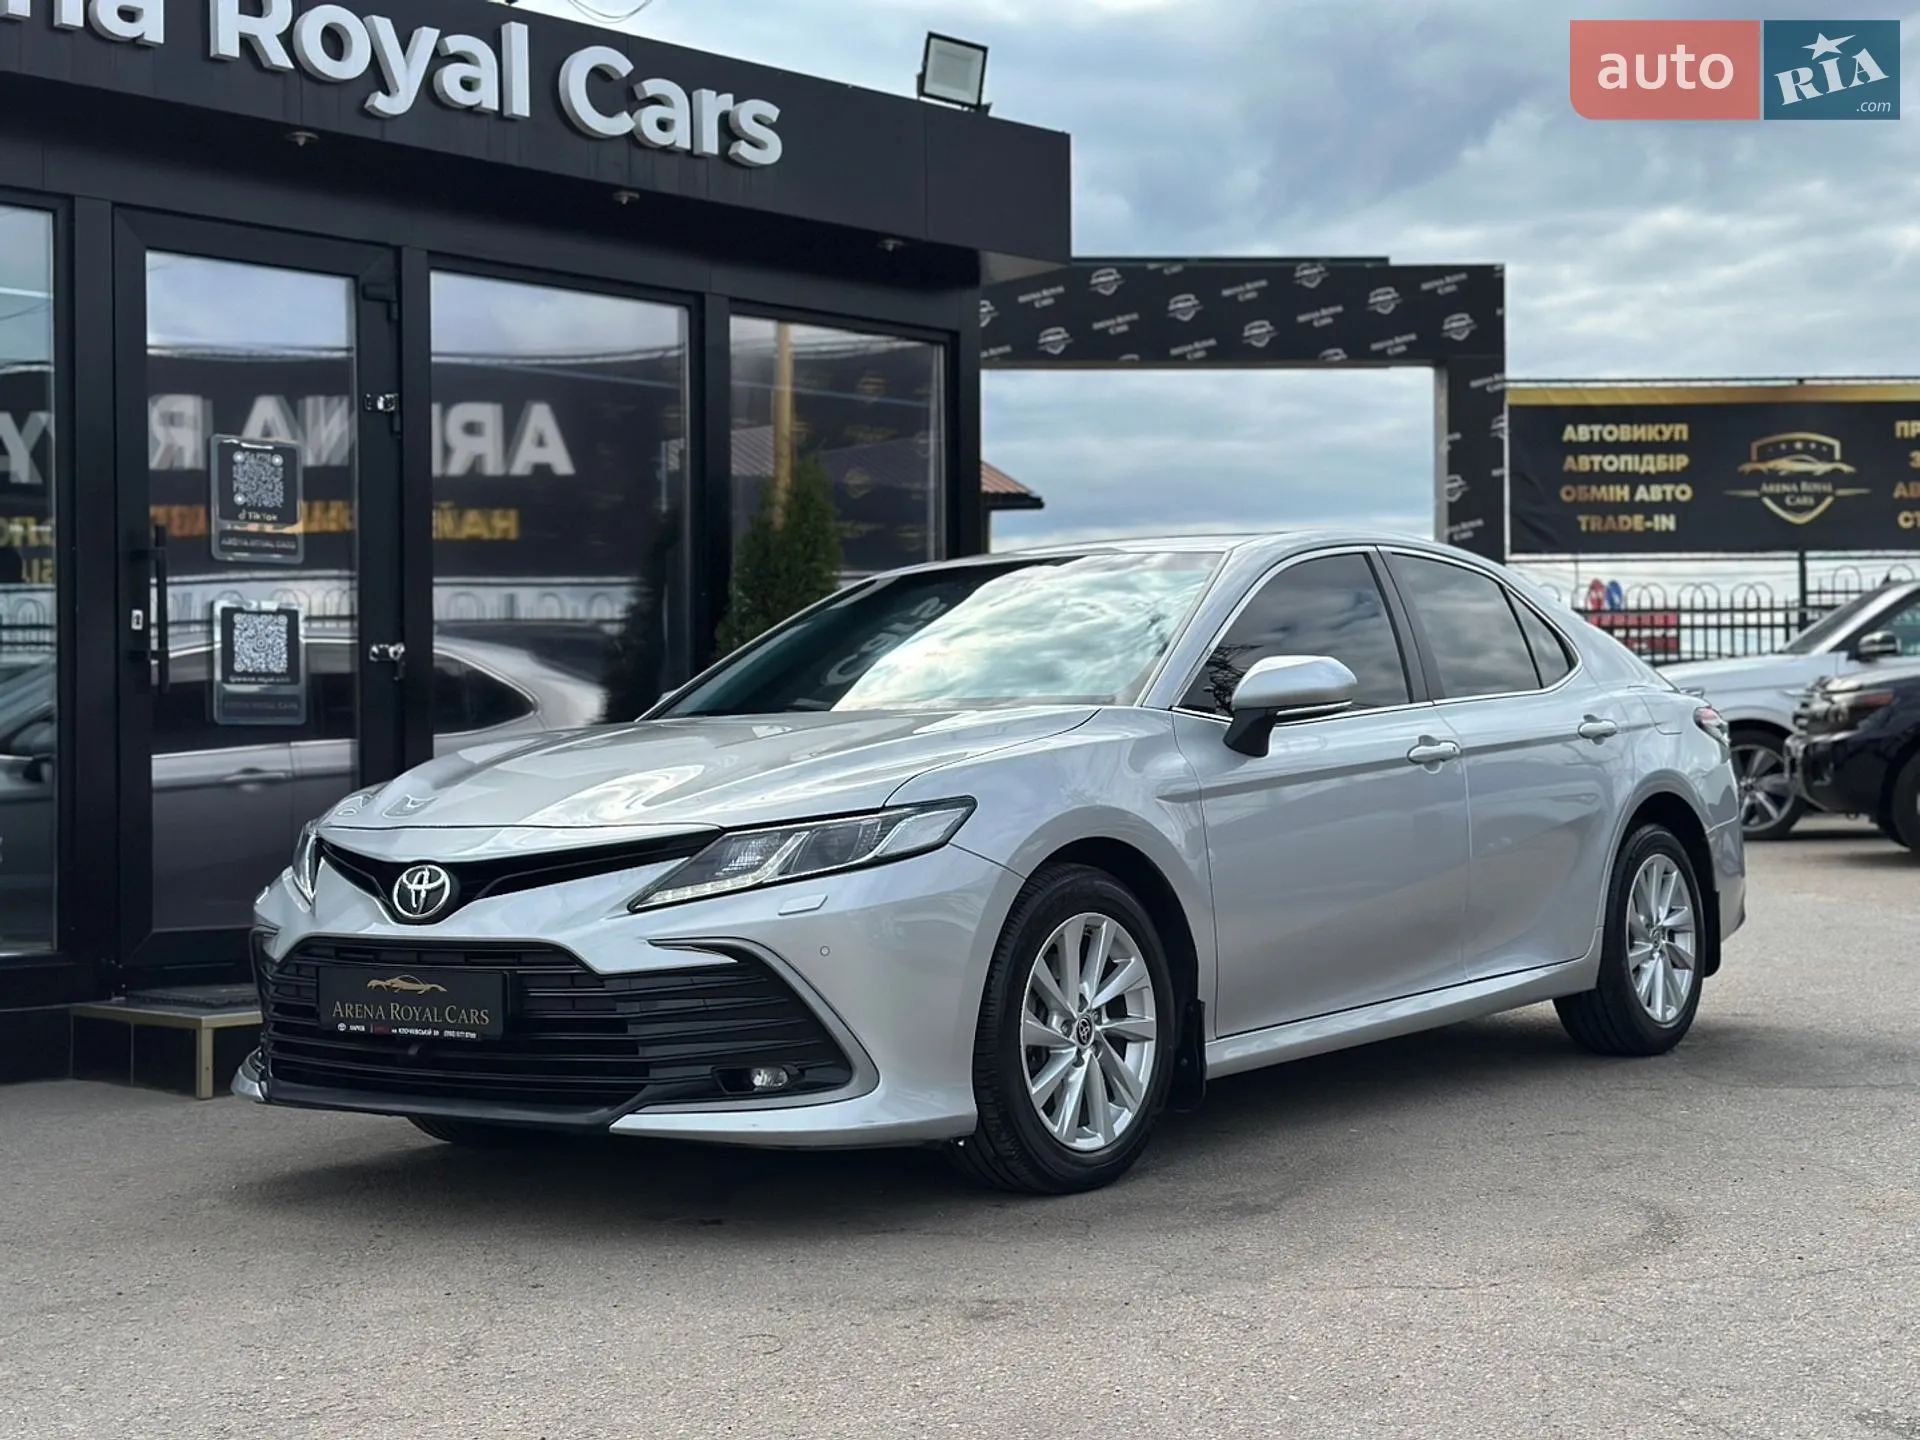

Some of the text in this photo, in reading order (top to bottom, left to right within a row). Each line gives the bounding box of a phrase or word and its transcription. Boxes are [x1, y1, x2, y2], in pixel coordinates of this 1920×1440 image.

[209, 0, 530, 120] Royal
[559, 45, 782, 167] Cars
[1562, 423, 1689, 442] АВТОВИКУП
[1563, 454, 1690, 474] АВТОПІДБІР
[1560, 484, 1693, 503] ОБМІН АВТО
[1577, 514, 1677, 532] TRADE-IN
[332, 1000, 490, 1025] ARENA ROYAL CARS
